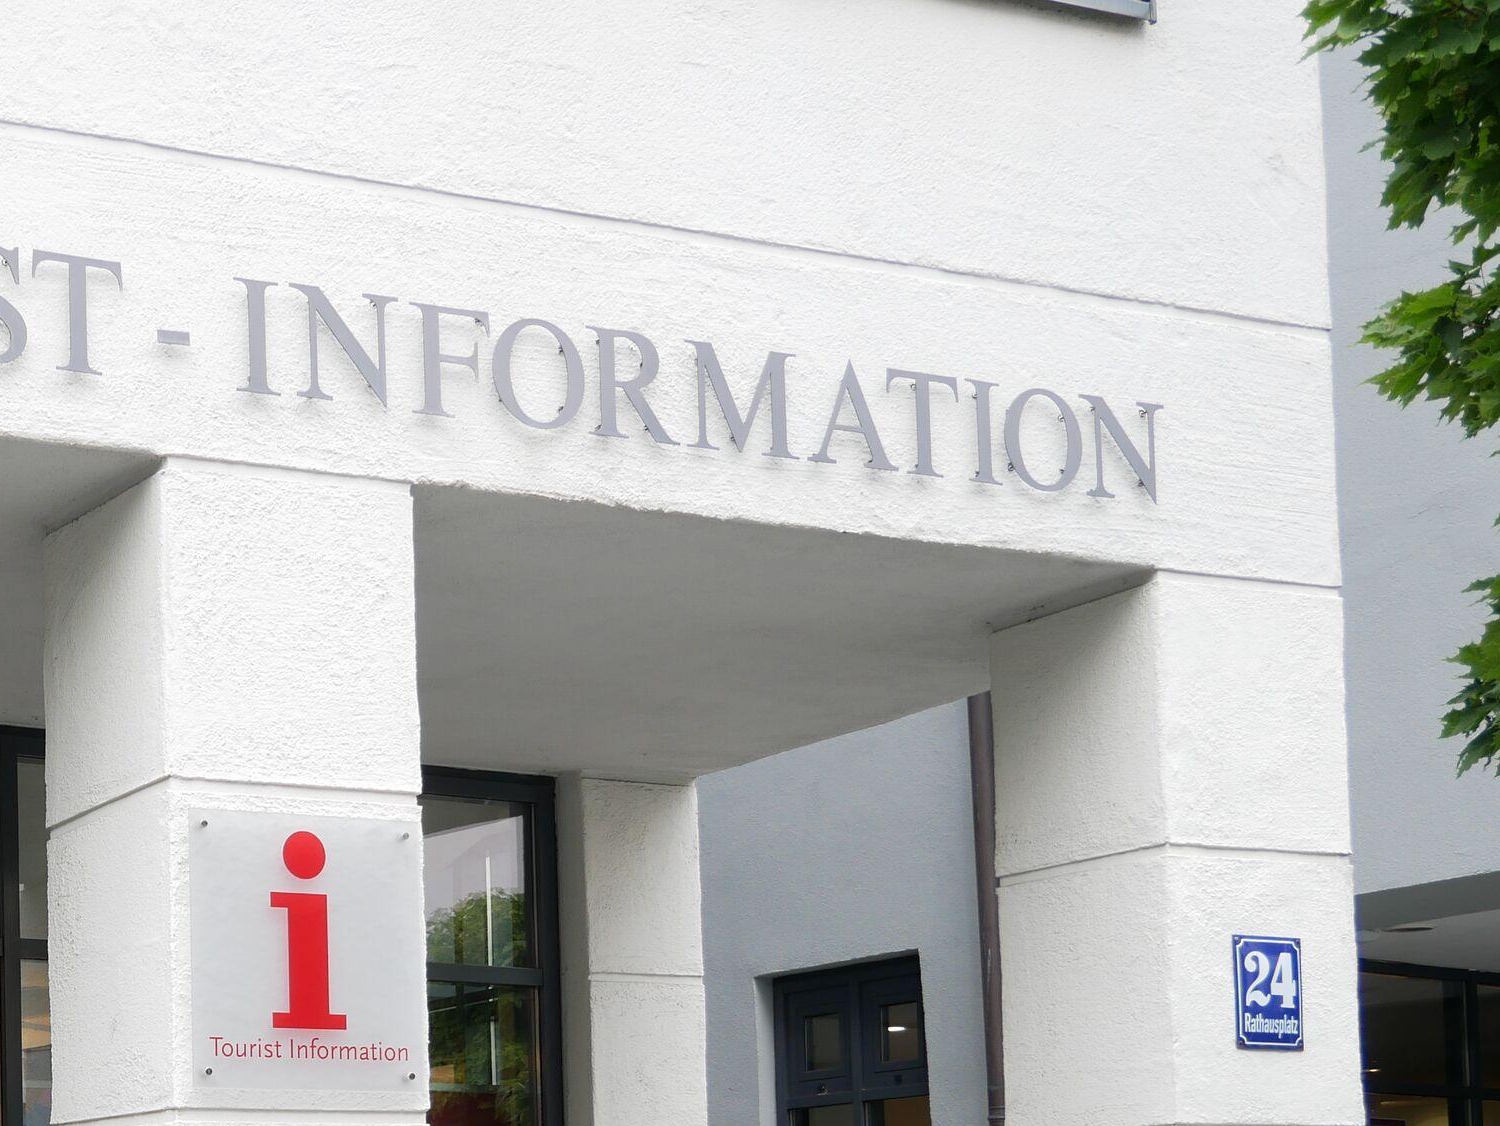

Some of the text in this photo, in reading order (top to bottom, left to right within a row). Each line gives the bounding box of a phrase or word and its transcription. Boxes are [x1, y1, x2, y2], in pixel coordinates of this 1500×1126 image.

[233, 276, 1164, 505] INFORMATION
[1244, 950, 1297, 1009] 24
[1244, 1012, 1299, 1039] Rathausplatz
[209, 1036, 409, 1061] Tourist Information
